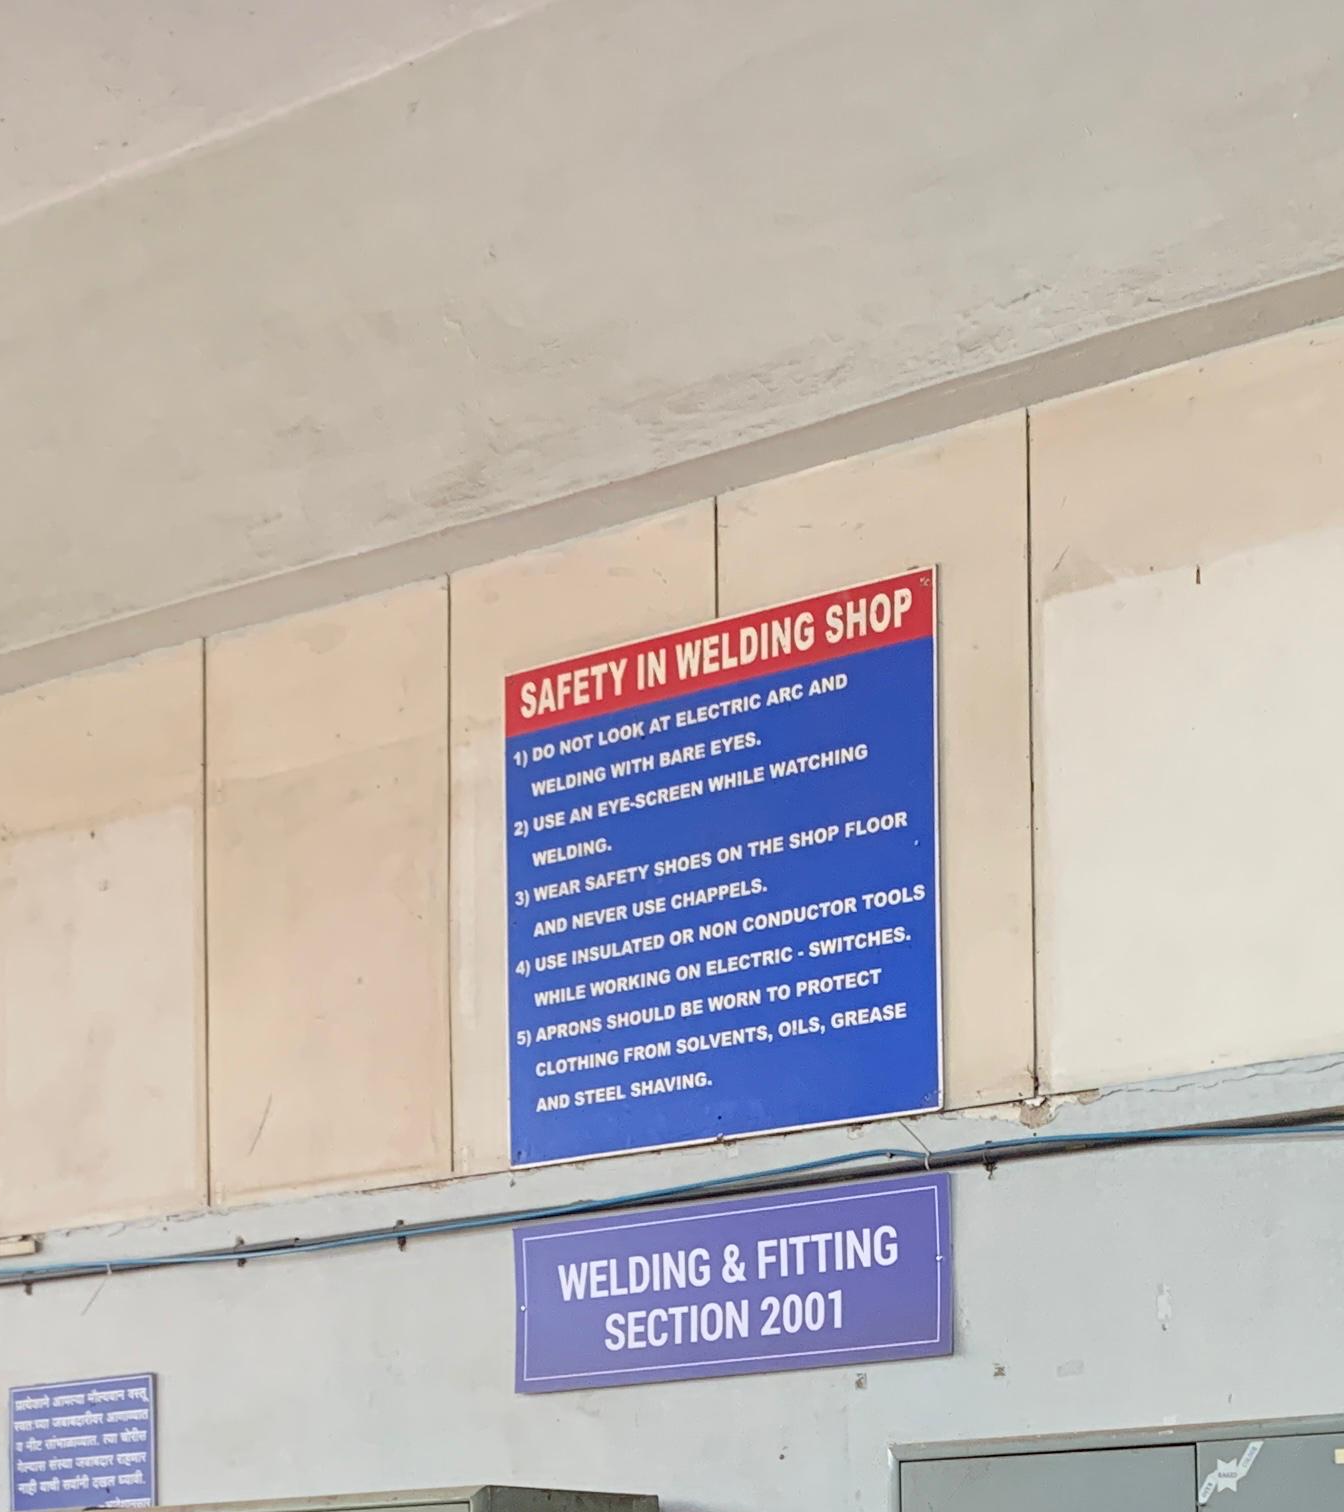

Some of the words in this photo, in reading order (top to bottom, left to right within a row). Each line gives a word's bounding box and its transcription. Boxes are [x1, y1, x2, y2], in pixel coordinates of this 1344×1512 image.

[520, 657, 627, 719] SAFETY
[636, 647, 666, 690] IN
[674, 610, 815, 680] WELDING
[824, 587, 912, 644] SHOP
[512, 749, 528, 769] 1)
[531, 742, 555, 762] DO
[558, 732, 594, 756] NOT
[597, 720, 645, 747] LOOK
[648, 713, 672, 734] AT
[674, 692, 762, 728] ELECTRIC
[765, 682, 804, 707] ARC
[807, 672, 848, 697] AND
[512, 818, 529, 838] 2)
[532, 810, 566, 832] USE
[568, 803, 593, 824] AN
[596, 779, 704, 818] EYE-SCREEN
[707, 765, 765, 793] WHILE
[768, 742, 868, 779] WATCHING
[530, 765, 607, 797] WELDING
[609, 753, 655, 779] WITH
[658, 742, 706, 768] BARE
[709, 730, 762, 756] EYES.
[513, 888, 531, 908] 3)
[532, 878, 581, 902] WEAR
[583, 862, 650, 892] SAFETY
[652, 850, 712, 877] SHOES
[715, 843, 743, 864] ON
[746, 835, 784, 857] THE
[788, 824, 840, 849] SHOP
[844, 810, 908, 838] FLOOR
[530, 836, 612, 867] WELDING.
[514, 958, 531, 978] 4)
[534, 951, 568, 972] USE
[570, 932, 665, 966] INSULATED
[668, 927, 695, 947] OR
[697, 918, 737, 941] NON
[741, 896, 857, 933] CONDUCTOR
[860, 883, 925, 910] TOOLS
[532, 916, 568, 938] AND
[570, 903, 628, 930] NEVER
[631, 895, 667, 918] USE
[669, 876, 768, 910] CHAPPELS.
[533, 983, 586, 1007] WHILE
[588, 967, 672, 997] WORKING
[674, 961, 701, 982] ON
[705, 945, 793, 977] ELECTRIC
[807, 925, 911, 958] SWITCHES.
[515, 1028, 532, 1048] 5)
[534, 1015, 603, 1043] APRONS
[605, 1003, 676, 1030] SHOULD
[679, 997, 704, 1017] BE
[706, 987, 761, 1012] WORN
[765, 983, 791, 1002] TO
[795, 967, 882, 998] PROTECT
[534, 1048, 619, 1078] CLOTHING
[622, 1039, 672, 1063] FROM
[674, 1024, 774, 1055] SOLVENTS,
[776, 1015, 826, 1038] OILS,
[829, 1001, 907, 1029] GREASE
[534, 1092, 571, 1113] AND
[573, 1083, 627, 1107] STEEL
[629, 1070, 713, 1098] SHAVING.
[557, 1247, 711, 1302] WELDING
[721, 1243, 746, 1284] &
[757, 1225, 899, 1280] FITTING
[604, 1299, 749, 1351] SECTION
[760, 1289, 844, 1336] 2001
